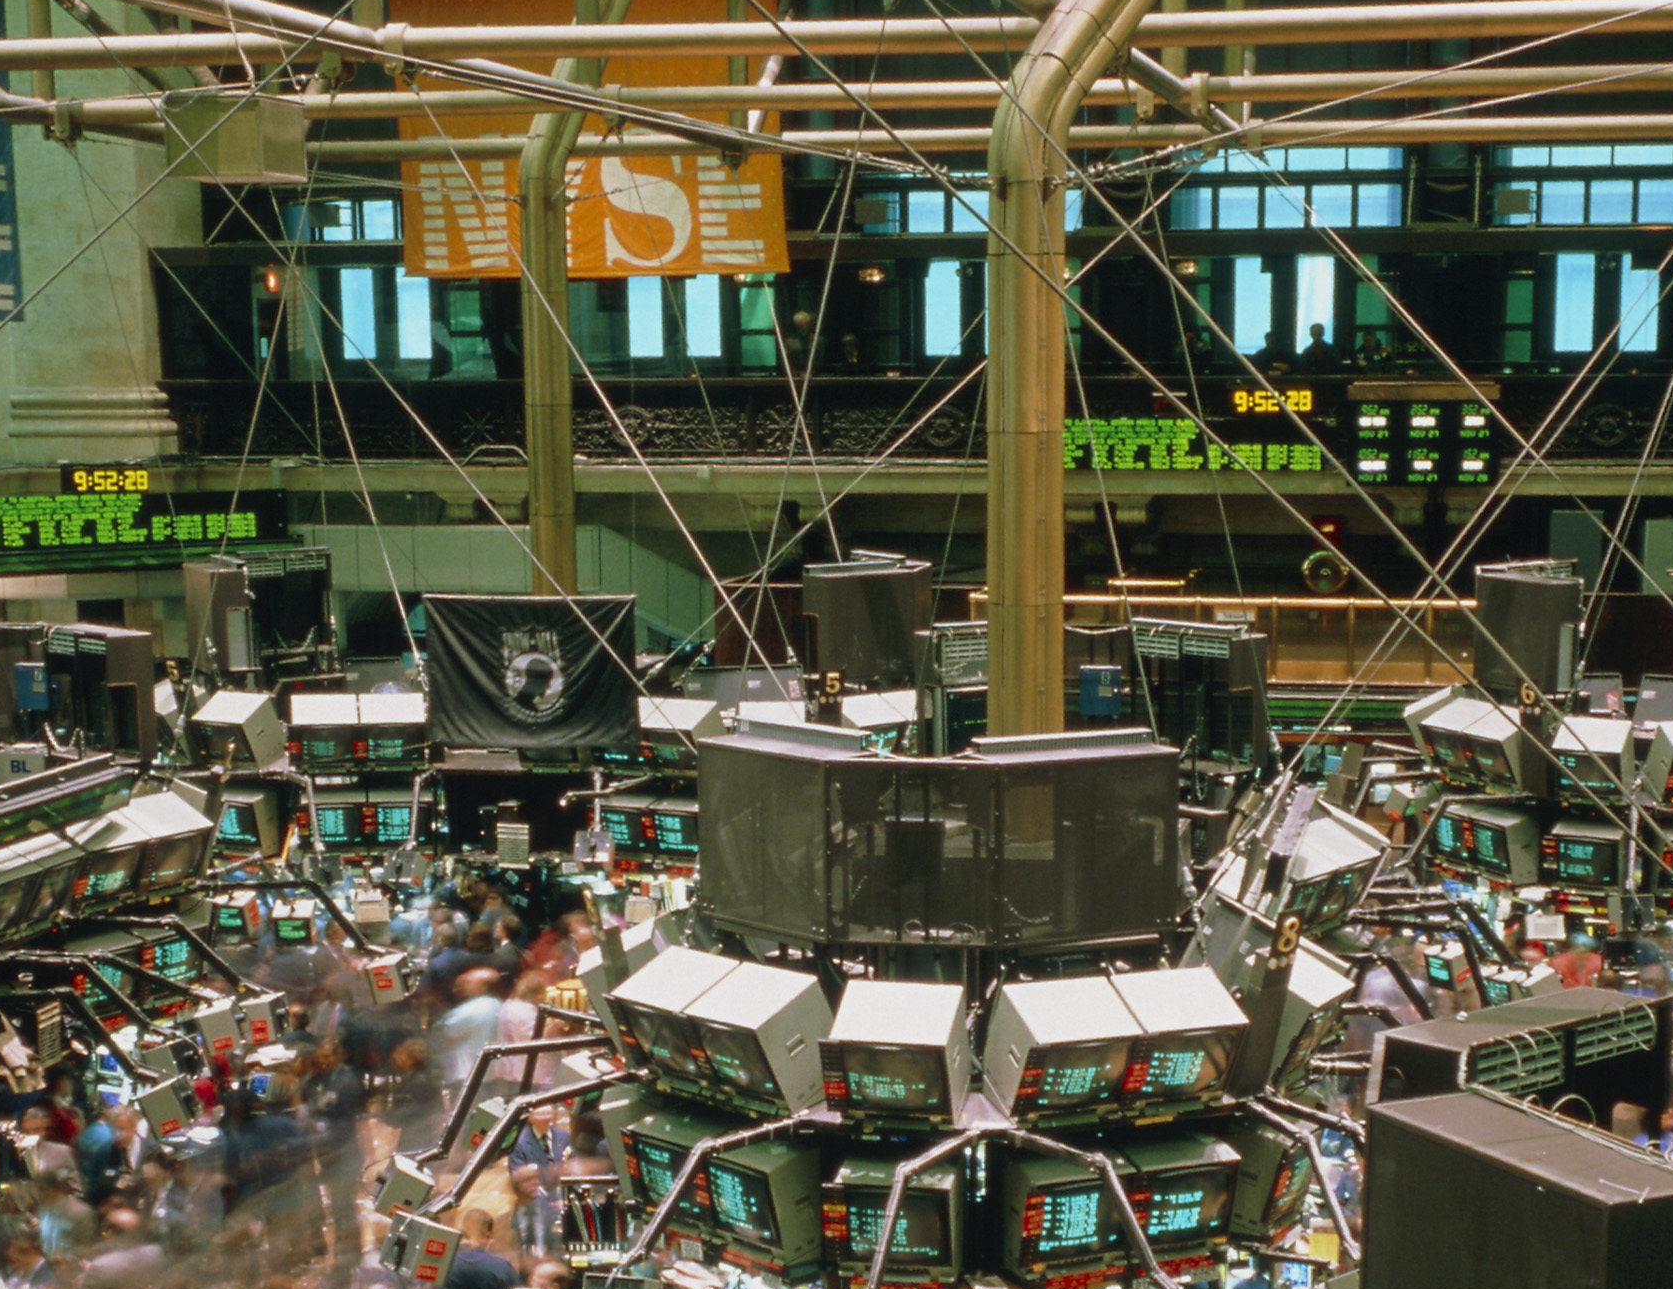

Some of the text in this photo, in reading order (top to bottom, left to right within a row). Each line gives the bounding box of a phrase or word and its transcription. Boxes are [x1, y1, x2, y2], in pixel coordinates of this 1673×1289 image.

[418, 127, 766, 269] NSE
[1234, 390, 1313, 413] 9:52:28
[73, 470, 148, 492] 9:52:28
[825, 672, 841, 694] 5
[1520, 683, 1536, 705] 6
[1276, 916, 1299, 953] 8
